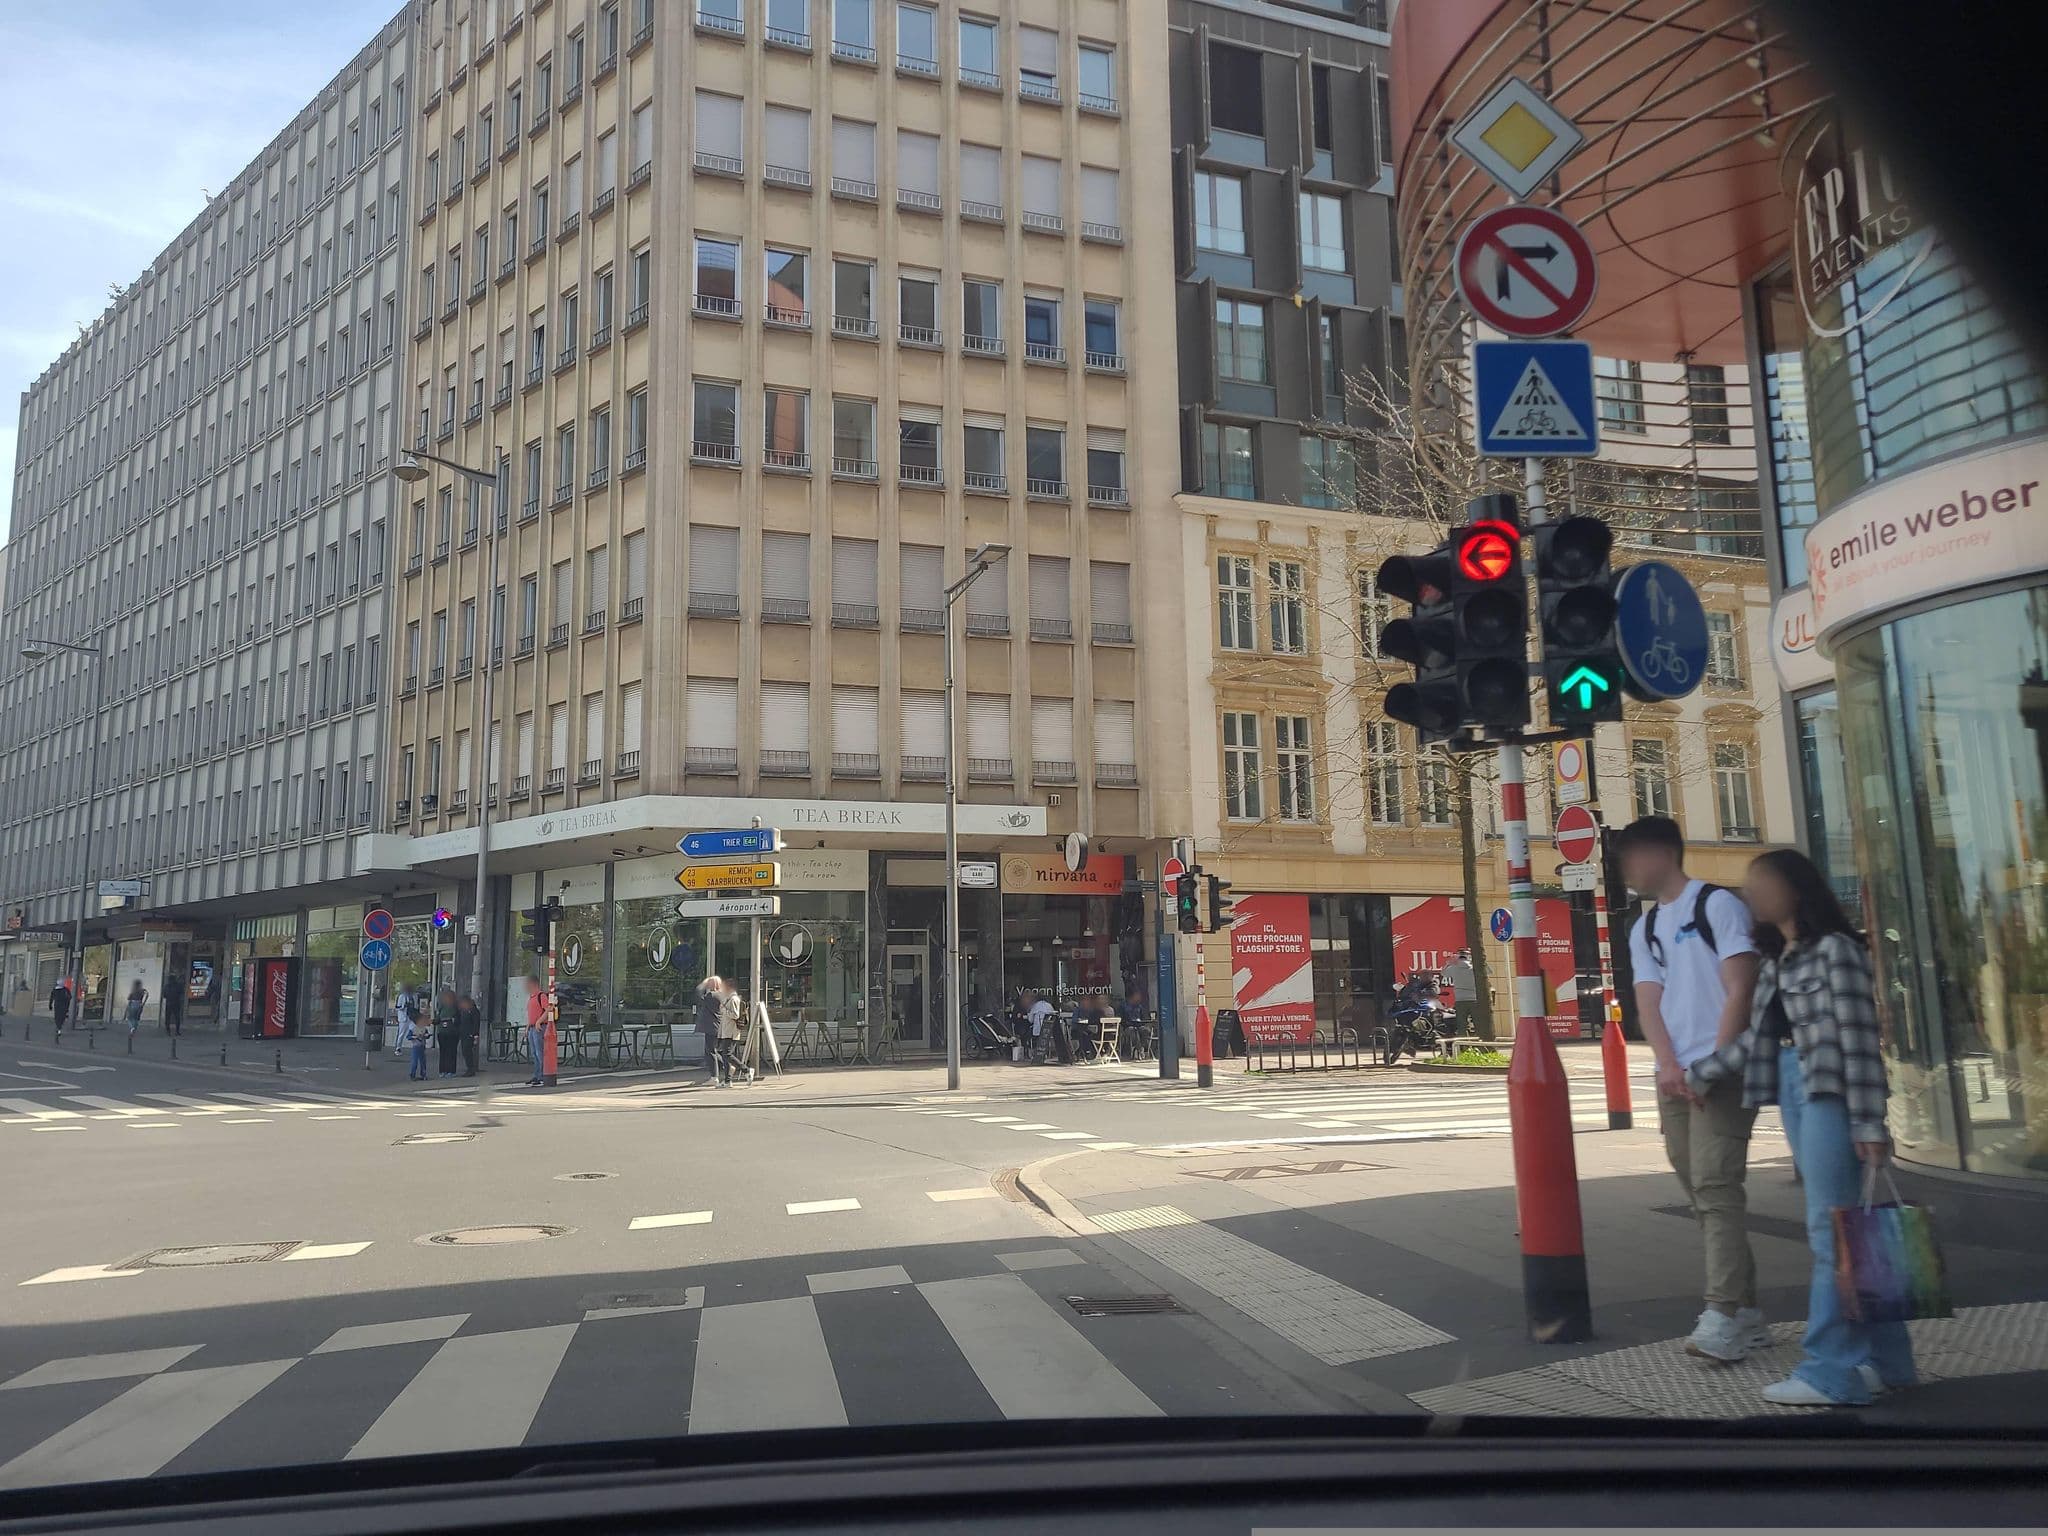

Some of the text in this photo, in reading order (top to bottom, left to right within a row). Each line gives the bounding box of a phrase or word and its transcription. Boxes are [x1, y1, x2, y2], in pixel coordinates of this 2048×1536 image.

[1811, 204, 1912, 293] EVENTS
[1830, 480, 2040, 569] emile weber
[1880, 548, 1914, 573] your
[1917, 528, 1992, 561] journey
[558, 809, 617, 833] TEA BREAK
[793, 808, 902, 825] TEA BREAK
[690, 840, 699, 849] 46
[722, 838, 741, 847] TRIER
[808, 859, 821, 867] Tea
[687, 868, 696, 877] 23
[728, 866, 753, 875] REMICH
[802, 871, 813, 879] Tea
[1036, 867, 1098, 882] nirvana
[687, 879, 696, 887] 99
[719, 903, 757, 912] Aéroport
[1263, 924, 1276, 934] ICI,
[1237, 934, 1303, 943] VOTRE PROCHAIN
[1236, 944, 1275, 953] FLAGSHIP
[1275, 944, 1300, 953] STORE
[1408, 950, 1443, 972] JLL
[1056, 984, 1112, 996] Restaurant
[1243, 1015, 1263, 1023] LOUER
[1263, 1014, 1282, 1023] ET/OU
